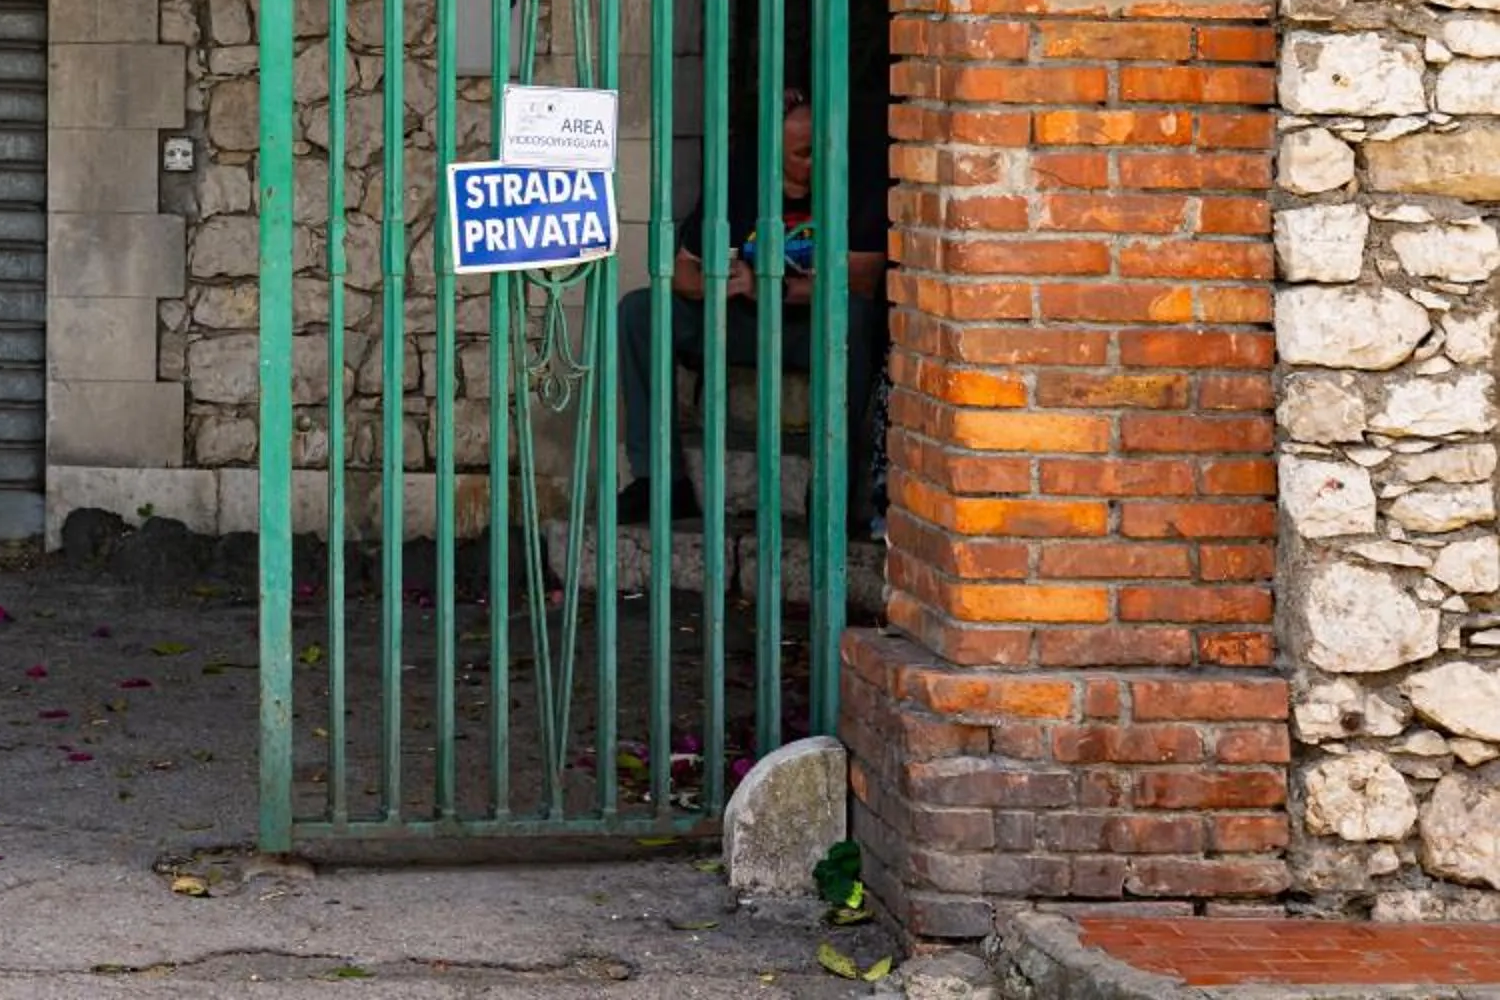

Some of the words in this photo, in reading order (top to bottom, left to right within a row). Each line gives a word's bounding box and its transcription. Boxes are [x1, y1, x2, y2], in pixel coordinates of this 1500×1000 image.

[561, 117, 606, 135] AREA
[465, 170, 597, 208] STRADA
[465, 212, 607, 252] PRIVATA
